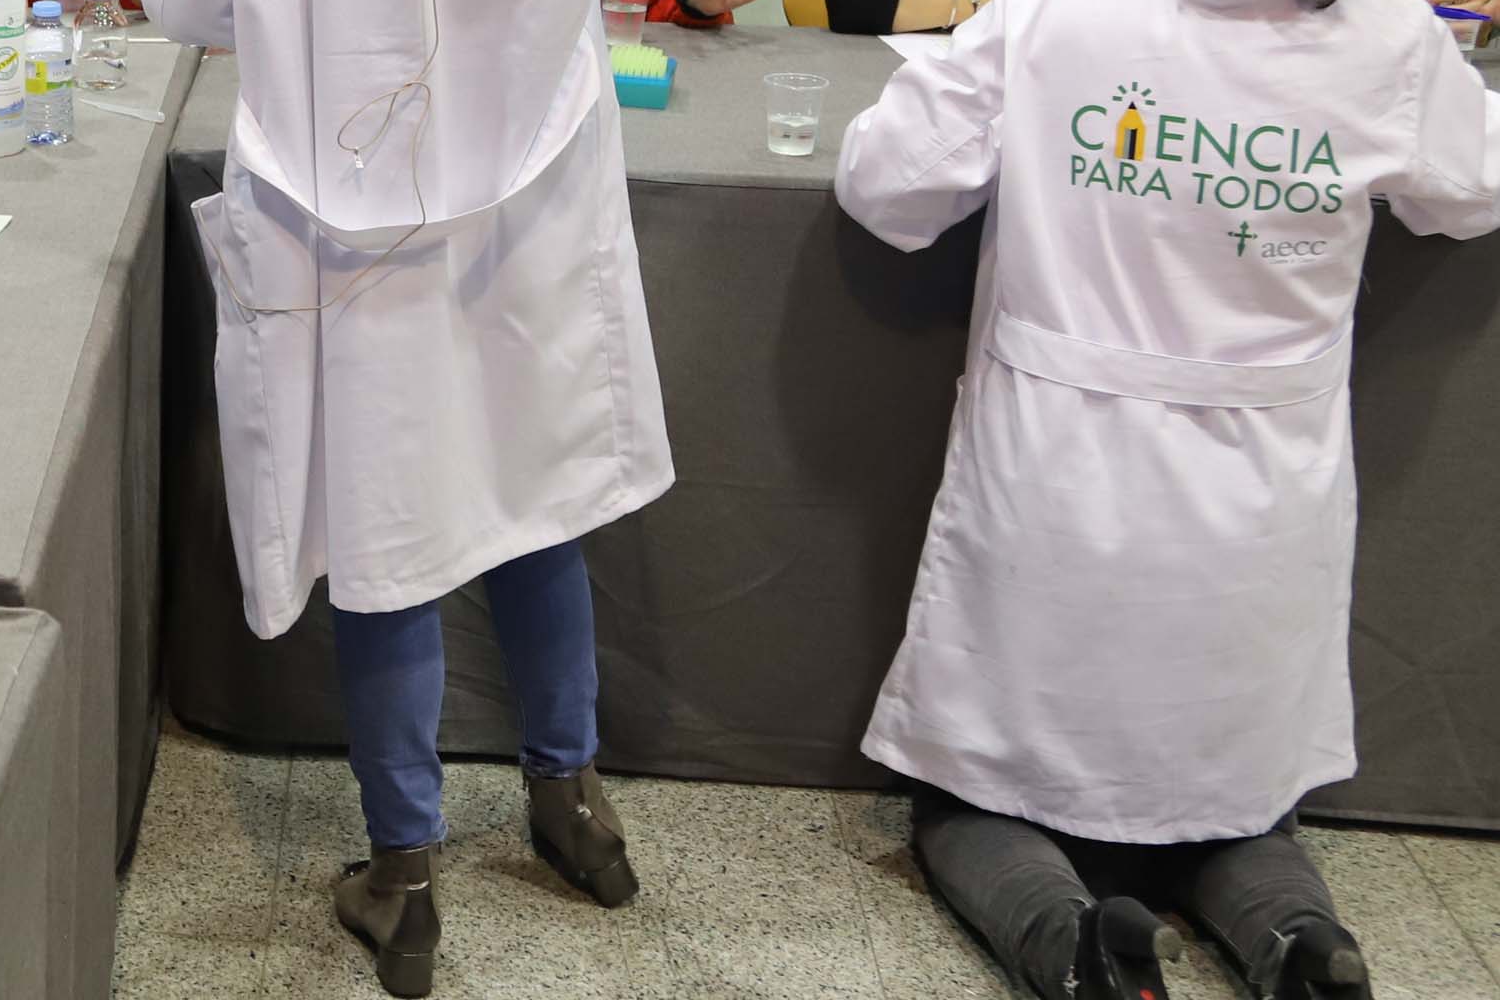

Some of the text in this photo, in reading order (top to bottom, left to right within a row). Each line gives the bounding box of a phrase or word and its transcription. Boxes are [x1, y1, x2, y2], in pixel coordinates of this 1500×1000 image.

[1070, 154, 1344, 214] PARA TODOS
[1260, 240, 1328, 258] aecc
